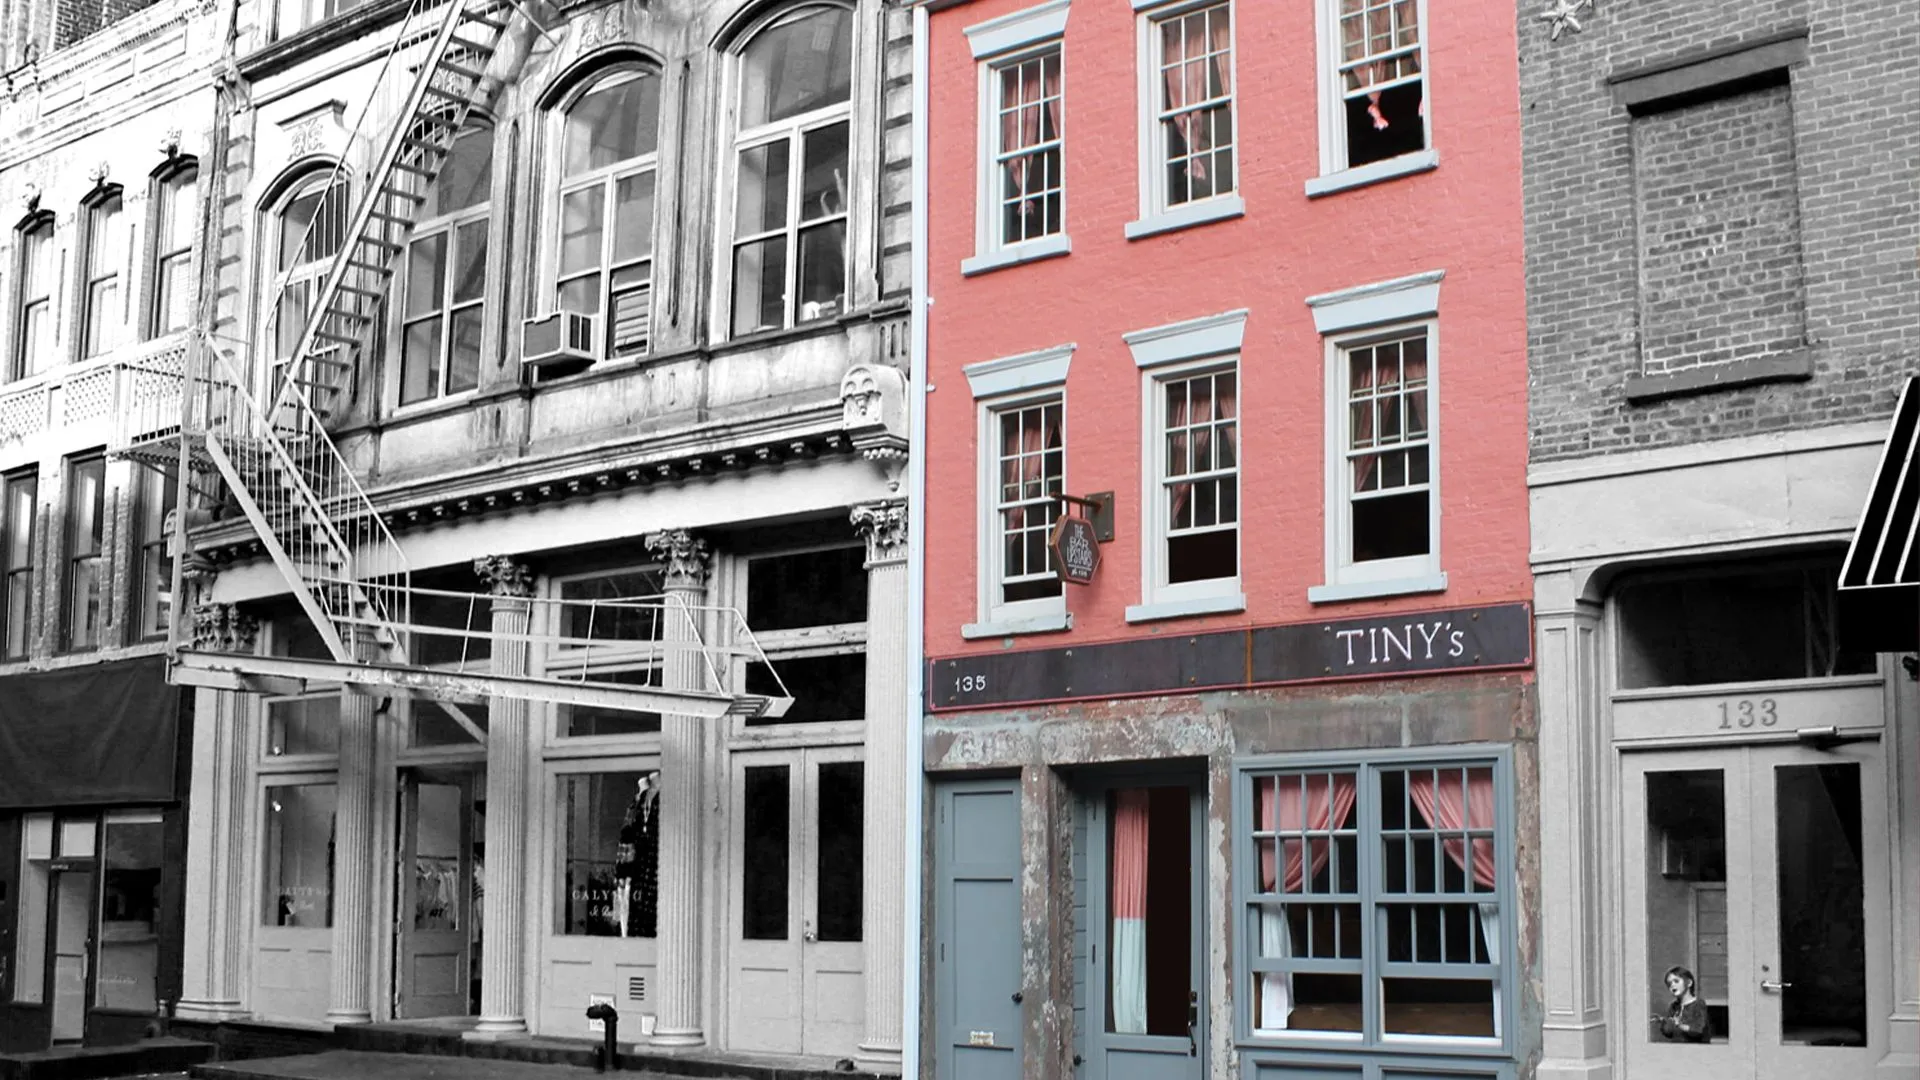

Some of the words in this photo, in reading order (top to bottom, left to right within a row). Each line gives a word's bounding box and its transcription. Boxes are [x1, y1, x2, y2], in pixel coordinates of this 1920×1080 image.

[1069, 535, 1089, 551] BAR
[1336, 622, 1464, 665] TINY's
[955, 675, 986, 693] 135
[1717, 699, 1778, 729] 133
